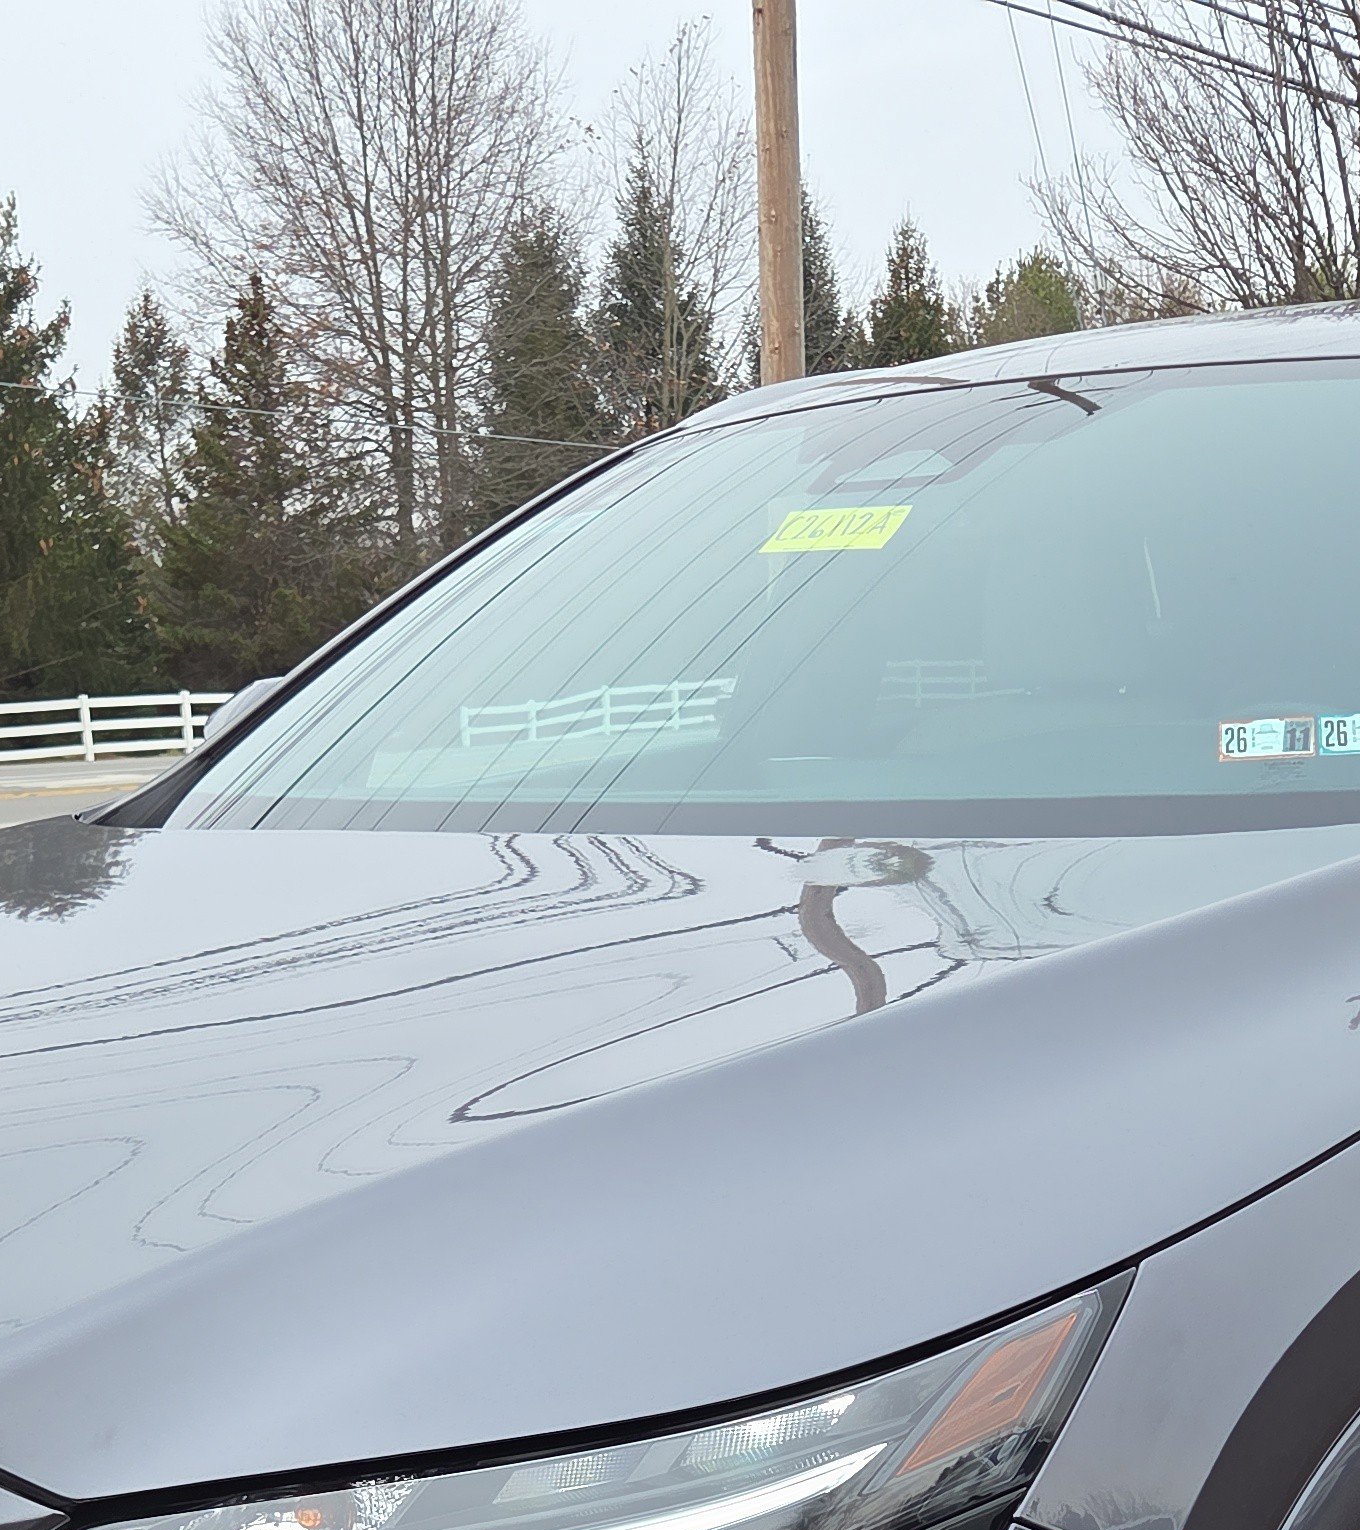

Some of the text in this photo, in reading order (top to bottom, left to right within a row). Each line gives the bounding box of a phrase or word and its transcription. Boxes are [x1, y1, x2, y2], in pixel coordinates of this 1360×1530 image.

[1224, 726, 1248, 753] 26
[1286, 727, 1311, 751] 11
[1324, 719, 1348, 747] 26
